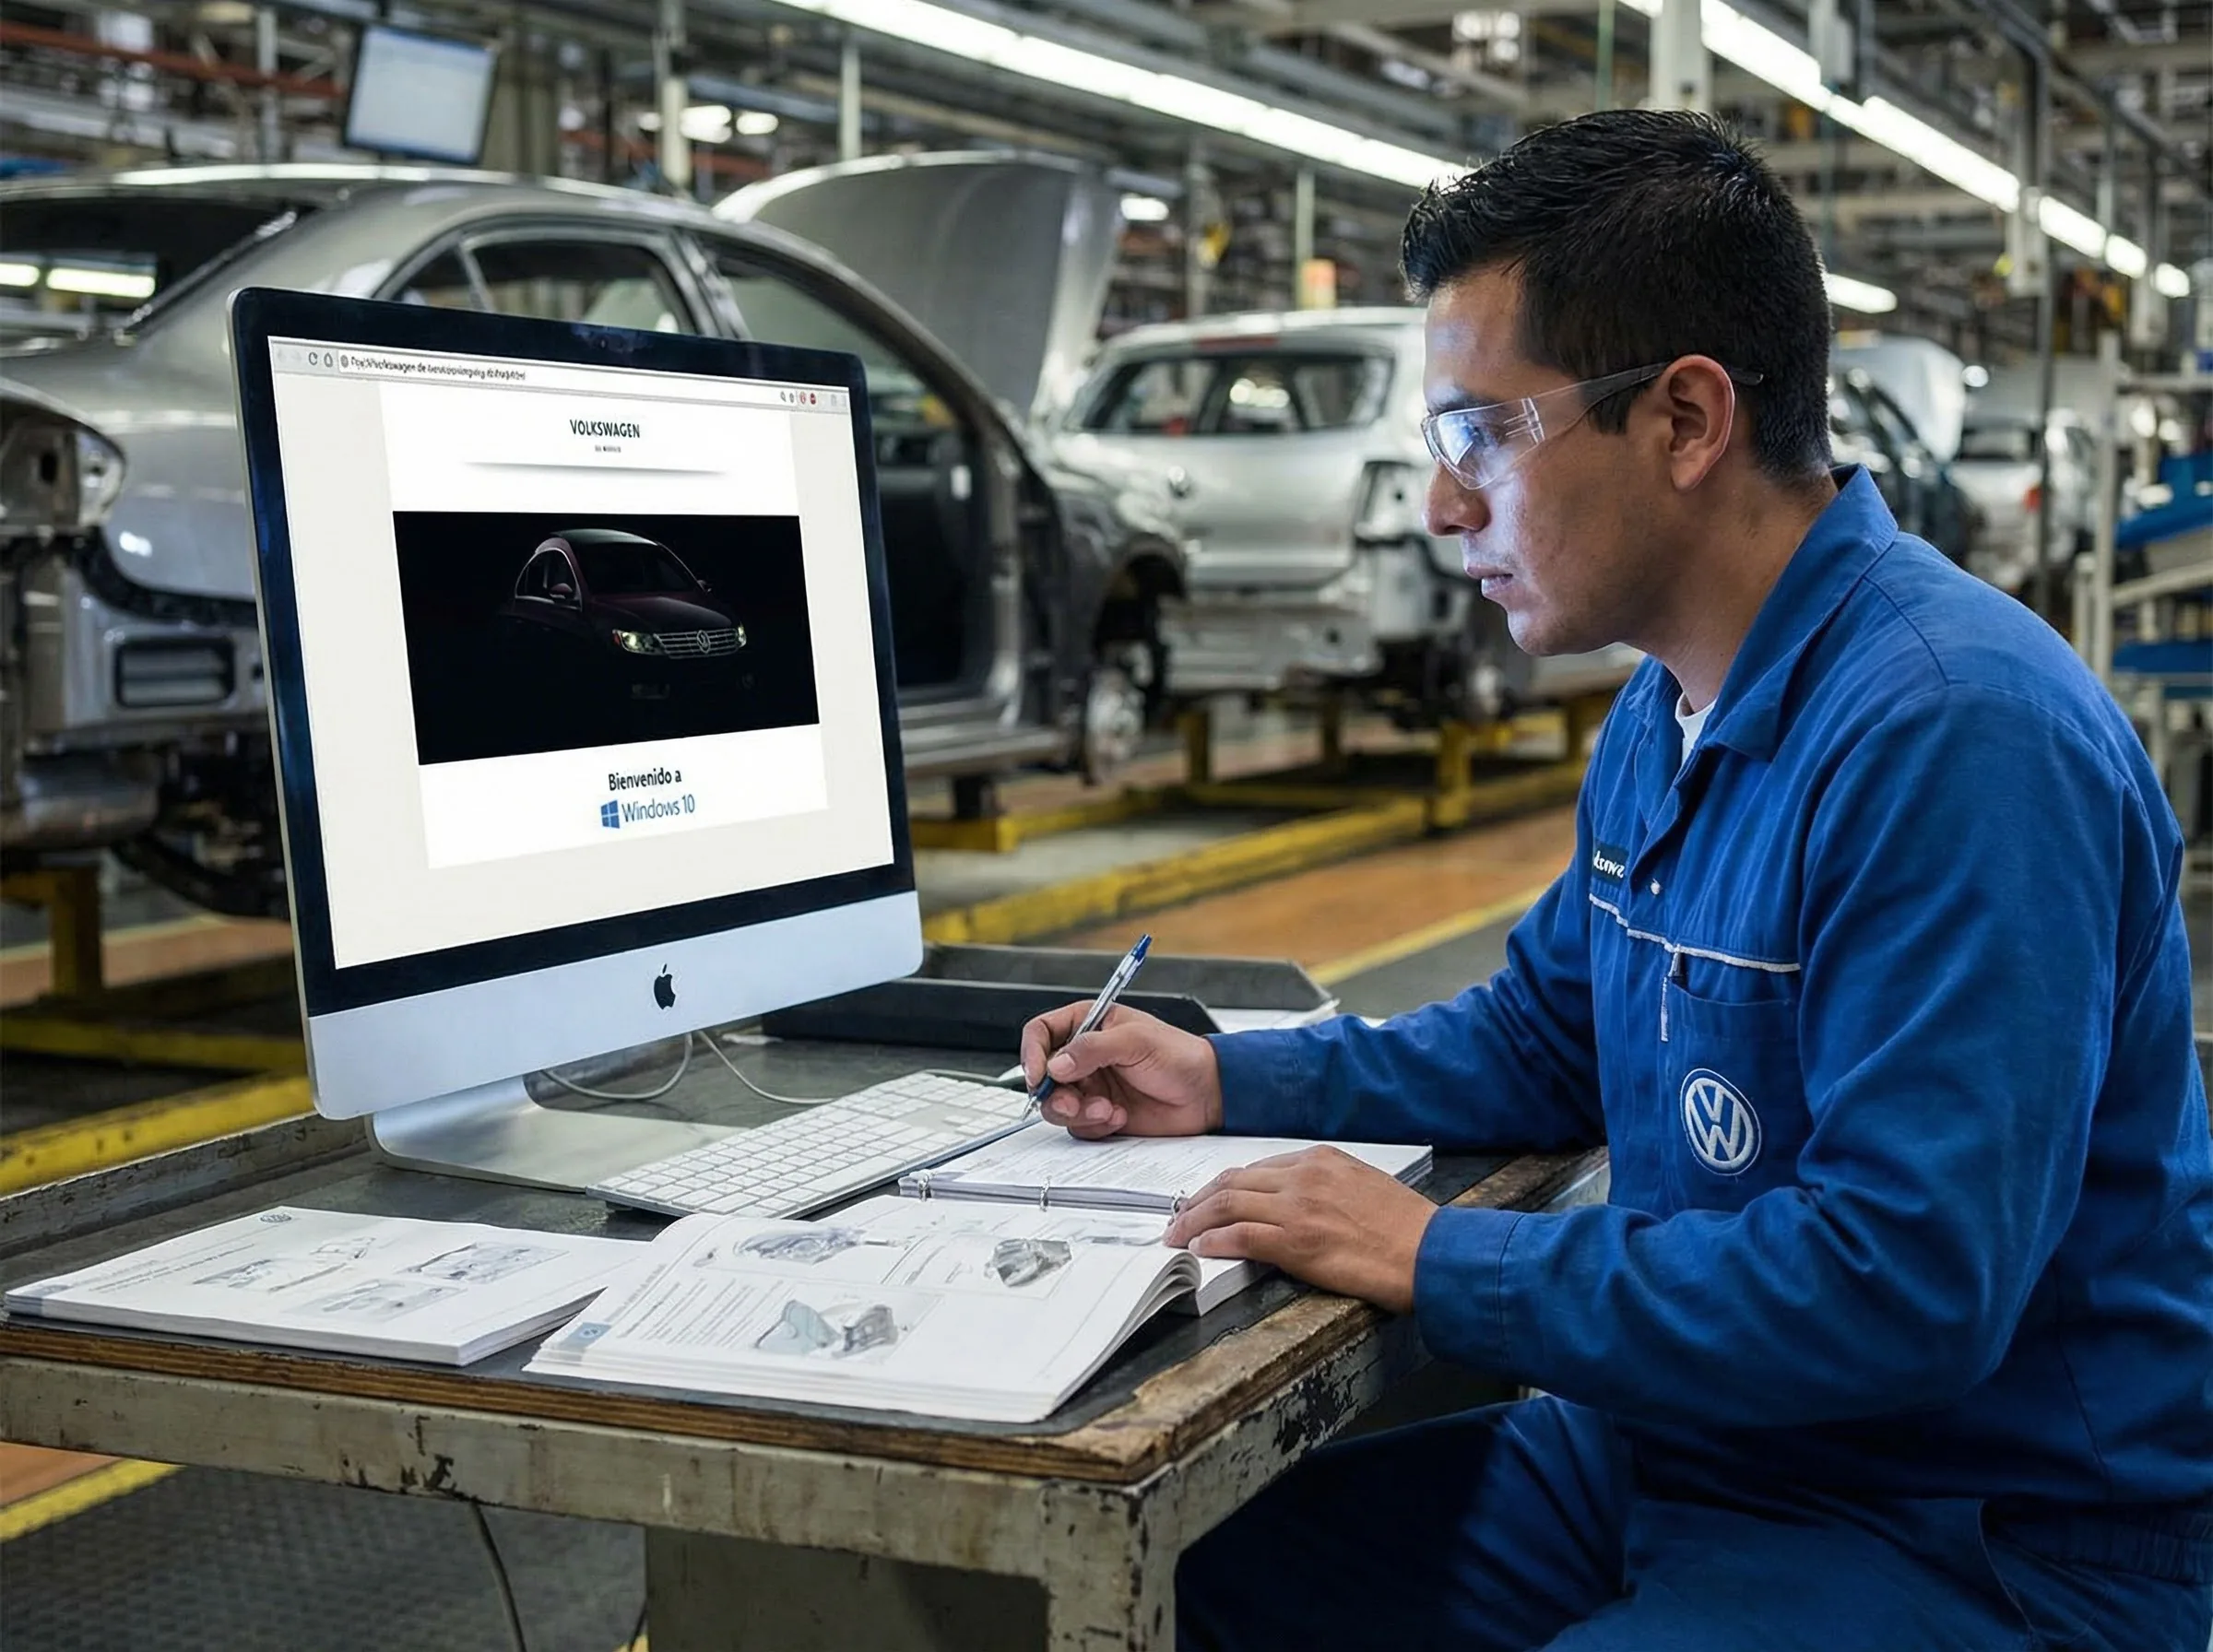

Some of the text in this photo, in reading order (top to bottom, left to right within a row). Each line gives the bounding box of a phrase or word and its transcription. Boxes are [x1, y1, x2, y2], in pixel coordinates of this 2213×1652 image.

[569, 419, 640, 438] VOLKSWAGEN
[609, 767, 682, 791] Bienvenido a
[621, 794, 695, 822] Windows 10
